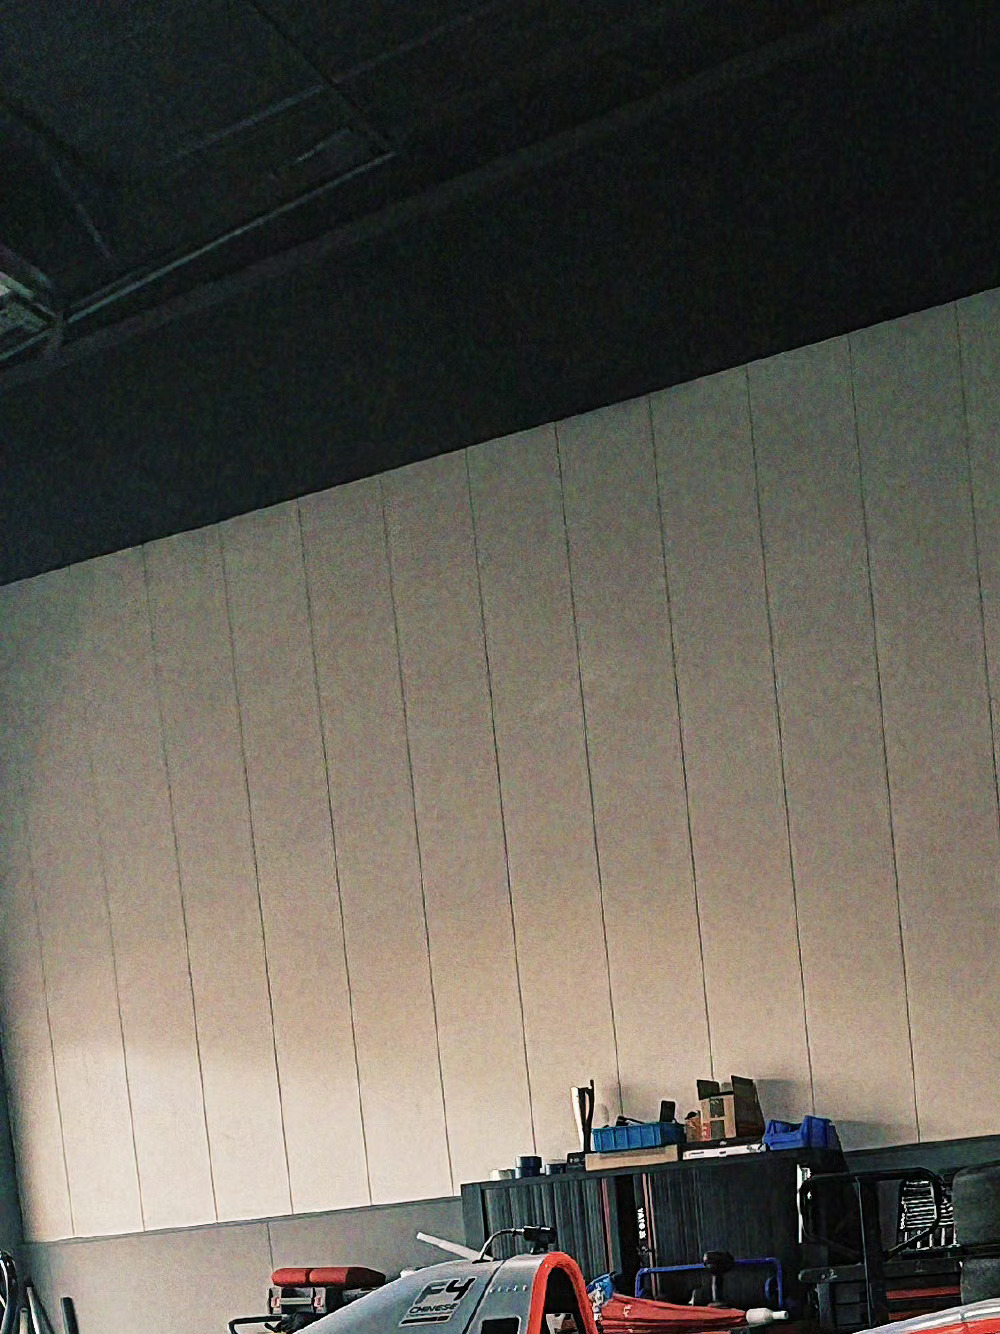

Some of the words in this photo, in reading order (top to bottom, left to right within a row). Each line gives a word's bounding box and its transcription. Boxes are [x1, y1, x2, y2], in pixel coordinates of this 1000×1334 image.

[637, 1207, 646, 1230] YATO
[415, 1277, 476, 1305] F4
[409, 1303, 459, 1314] CHINESE
